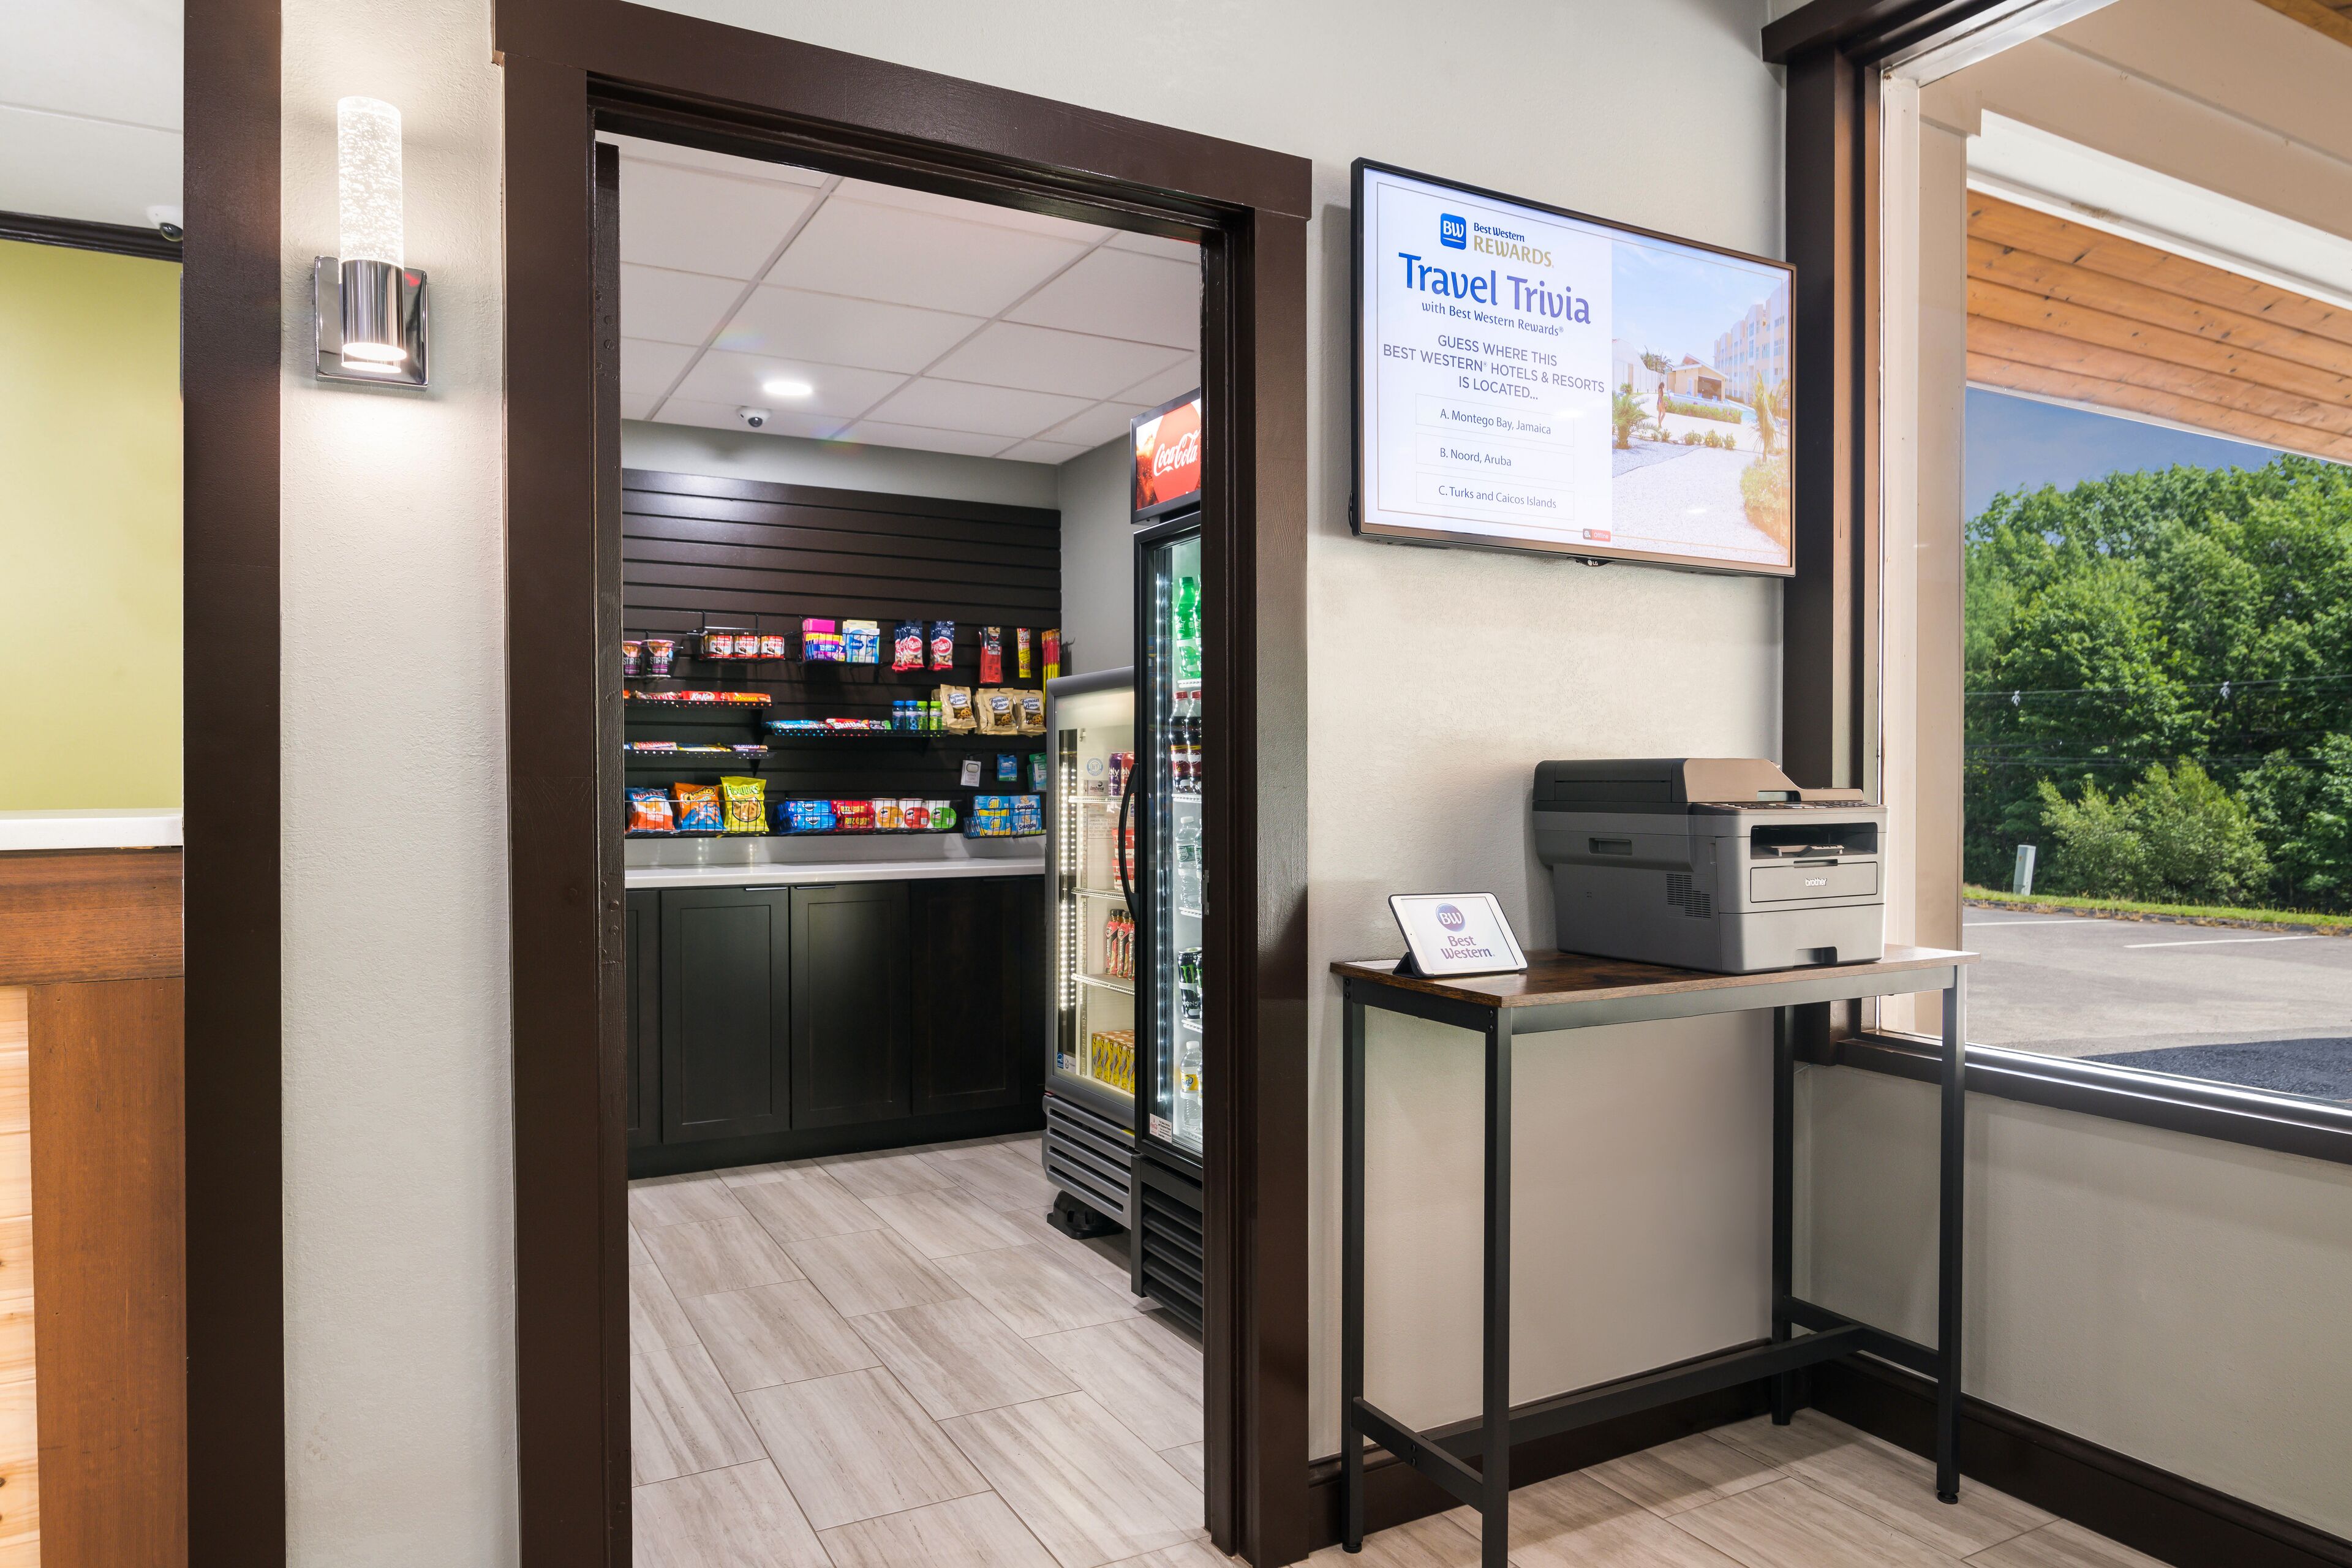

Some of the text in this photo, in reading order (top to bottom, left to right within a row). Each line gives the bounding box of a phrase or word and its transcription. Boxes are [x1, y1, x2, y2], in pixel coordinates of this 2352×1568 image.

[1443, 220, 1464, 237] BW
[1474, 222, 1525, 243] Best Western
[1398, 252, 1591, 325] Travel Trivia
[1422, 302, 1446, 315] with
[1450, 307, 1471, 320] Best
[1474, 311, 1515, 328] Western
[1438, 334, 1558, 367] GUESS WHERE THIS
[1383, 344, 1416, 361] BEST
[1491, 363, 1537, 382] HOTELS
[1540, 372, 1549, 384] &
[1553, 374, 1604, 393] RESORTS
[1459, 375, 1539, 401] IS LOCATED...
[1440, 408, 1551, 435] A. Montego Bay, Jamaica
[1153, 428, 1200, 477] Coca-Cola
[1440, 447, 1512, 467] B. Noord, Aruba
[1438, 484, 1557, 510] C. Turks and Caicos Islands
[948, 693, 967, 701] Famous
[989, 697, 1009, 706] Famous
[1109, 767, 1119, 777] bly
[632, 791, 665, 800] RUFFLES
[684, 786, 715, 804] Cheetos
[989, 798, 1000, 809] all
[990, 818, 1000, 829] all
[1805, 878, 1828, 886] brother
[1439, 912, 1462, 925] BW
[1447, 935, 1477, 946] Best
[1441, 948, 1493, 959] Western
